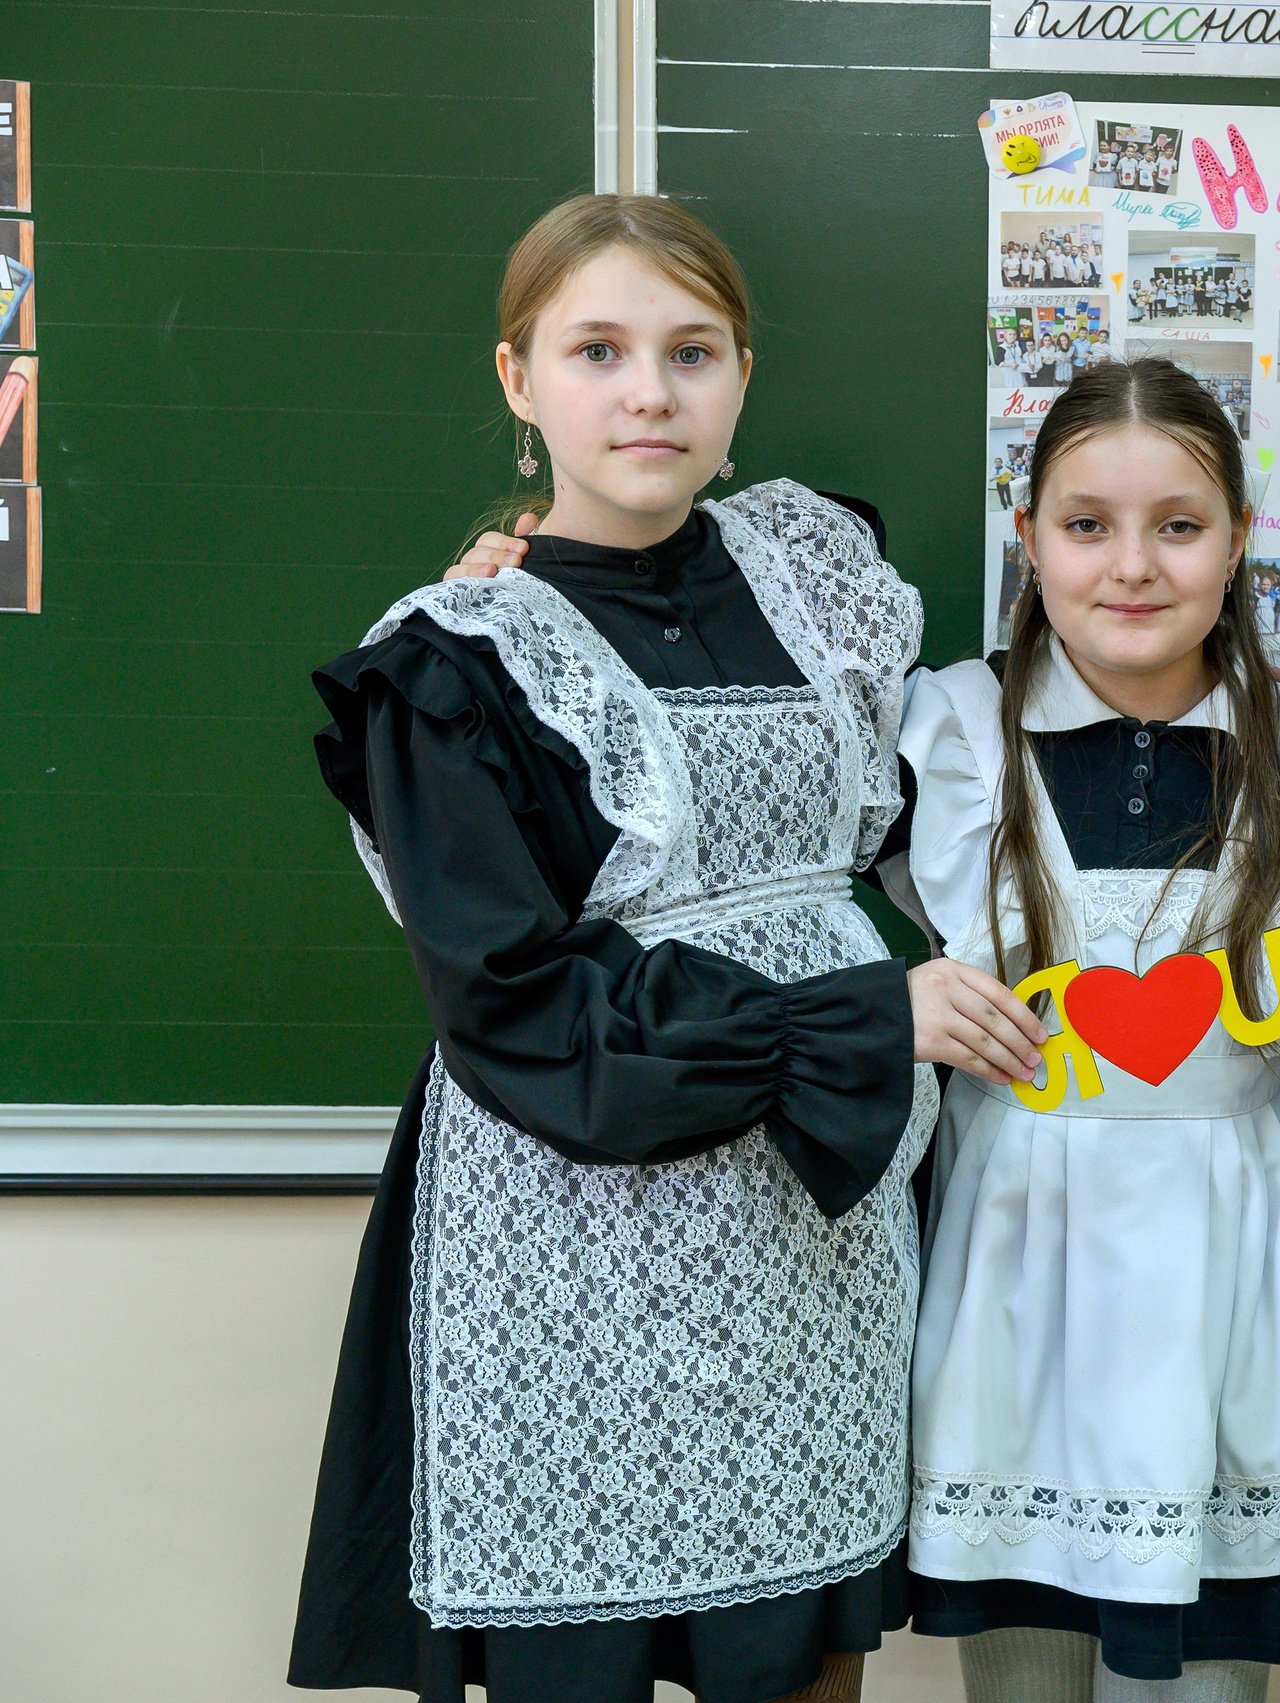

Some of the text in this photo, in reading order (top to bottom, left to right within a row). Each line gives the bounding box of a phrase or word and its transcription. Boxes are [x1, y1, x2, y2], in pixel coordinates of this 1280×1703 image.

[995, 115, 1066, 144] МЫ ОРЛЯТА
[1016, 184, 1090, 207] ТИМА
[1161, 328, 1210, 341] САША
[1007, 958, 1105, 1112] Я
